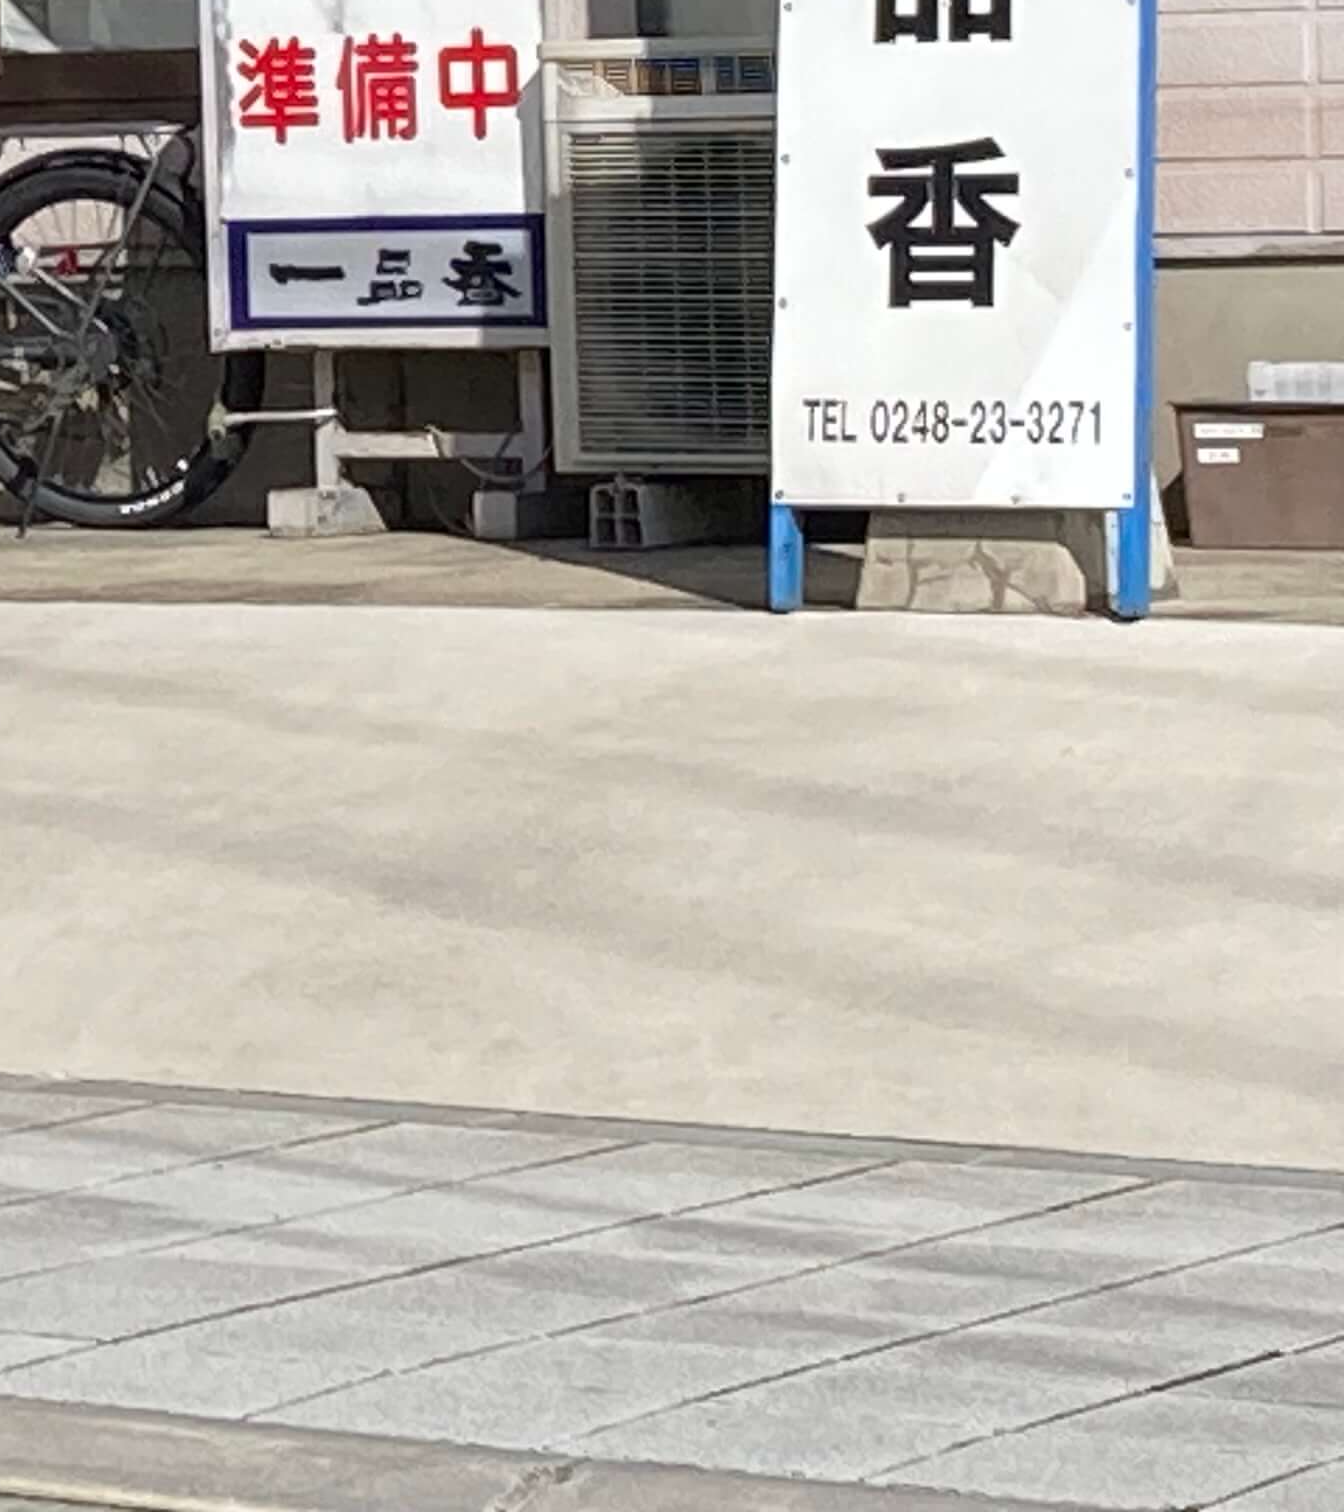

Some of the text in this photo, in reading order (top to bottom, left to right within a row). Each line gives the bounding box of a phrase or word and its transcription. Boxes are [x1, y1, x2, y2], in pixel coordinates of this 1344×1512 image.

[237, 28, 521, 143] 準備中
[269, 240, 523, 308] 一品香
[802, 398, 1101, 445] TEL 0248-23-3271
